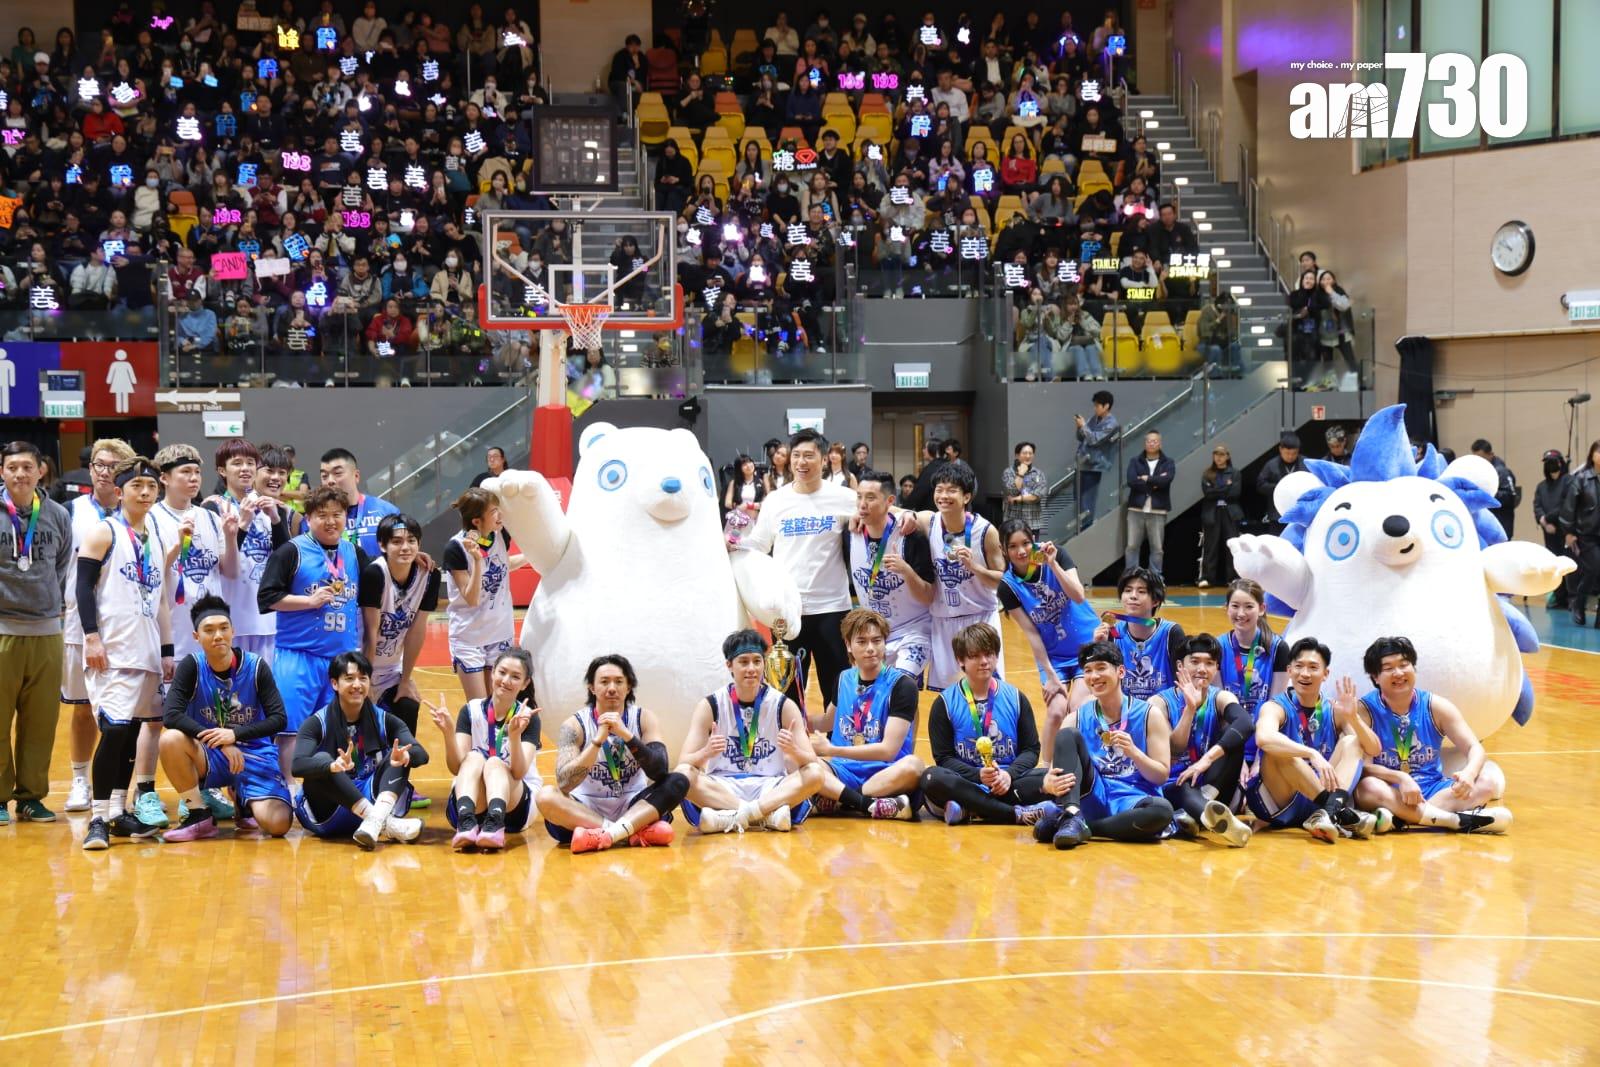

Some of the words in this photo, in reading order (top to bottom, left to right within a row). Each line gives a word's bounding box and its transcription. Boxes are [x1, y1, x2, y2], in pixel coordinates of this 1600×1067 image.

[281, 151, 311, 171] 193
[1092, 258, 1120, 270] STANLEY
[1127, 288, 1155, 300] STANLEY
[324, 612, 346, 632] 99
